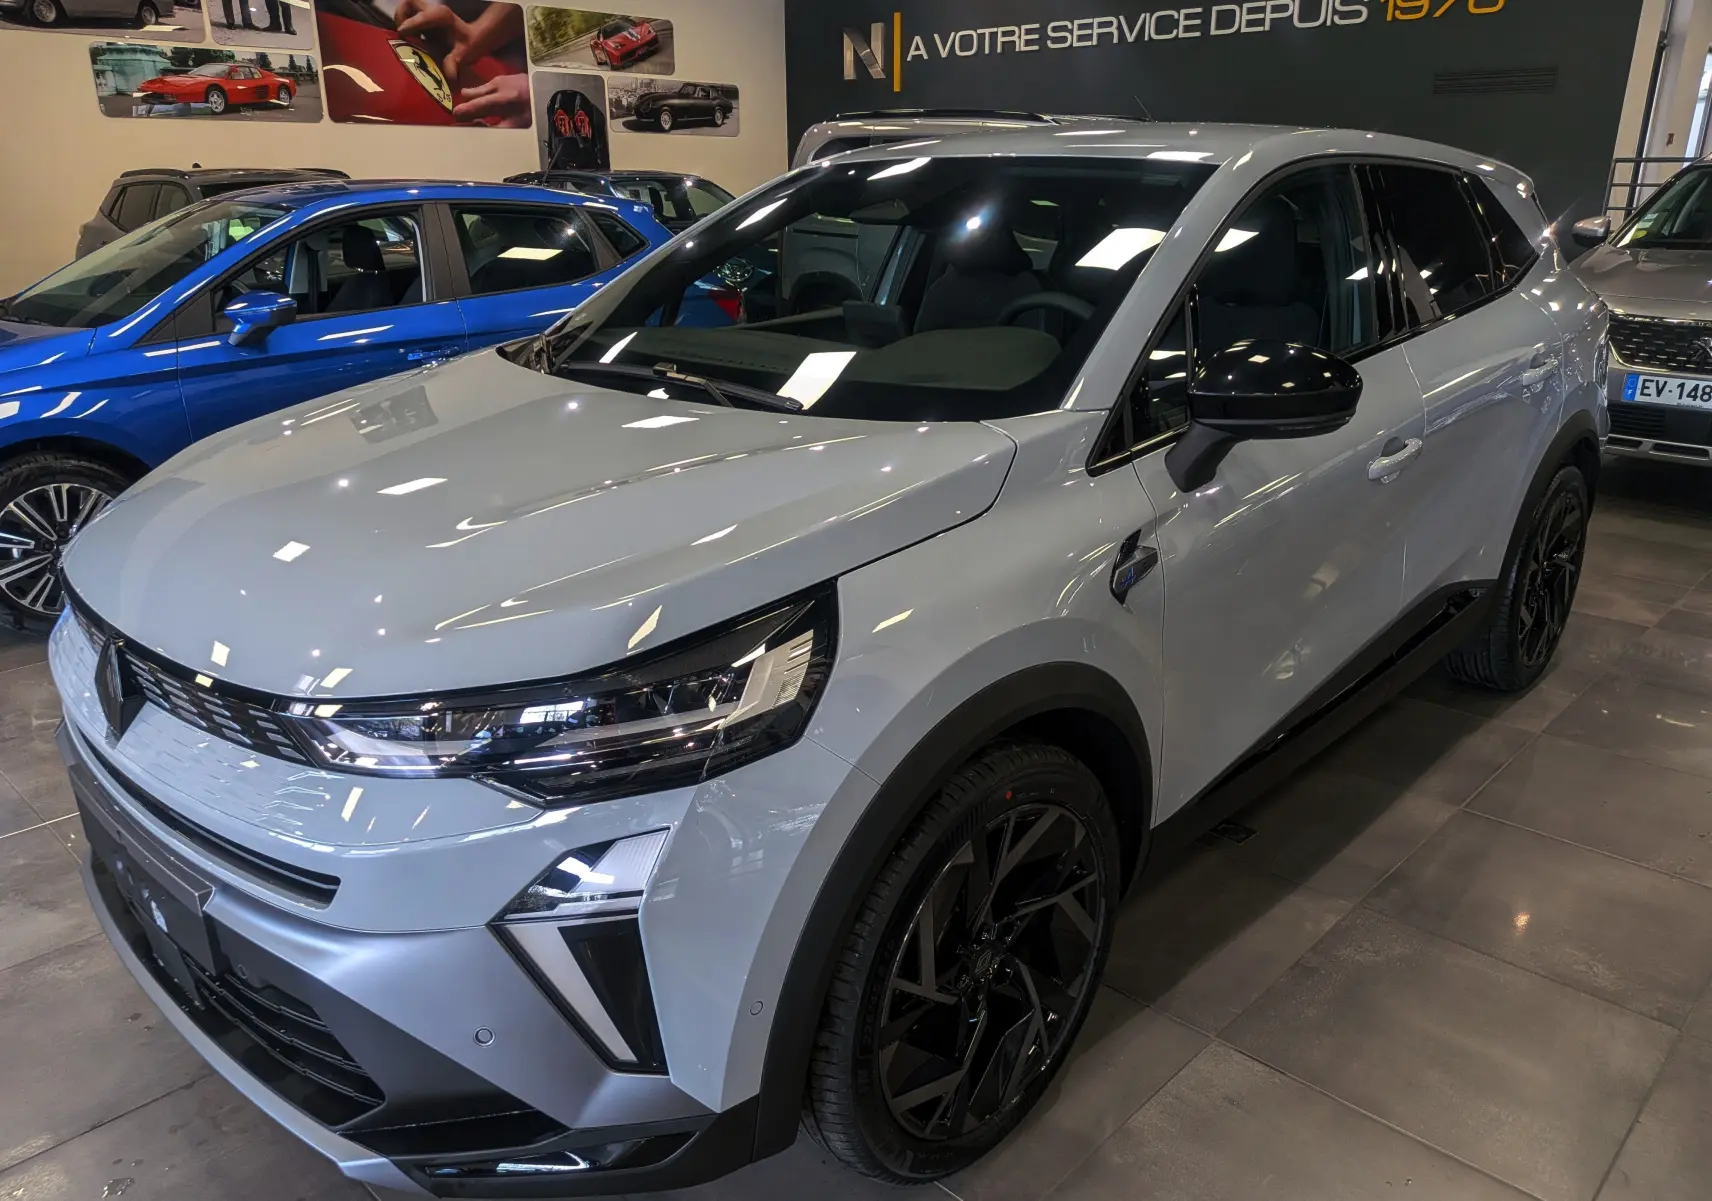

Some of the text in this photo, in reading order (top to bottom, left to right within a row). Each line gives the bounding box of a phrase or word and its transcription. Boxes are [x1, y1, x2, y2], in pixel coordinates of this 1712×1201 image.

[907, 35, 929, 62] A
[933, 23, 1040, 58] VOTRE
[1046, 7, 1204, 49] SERVICE
[1209, 0, 1369, 36] DEPUIS
[1639, 378, 1712, 403] EV-148
